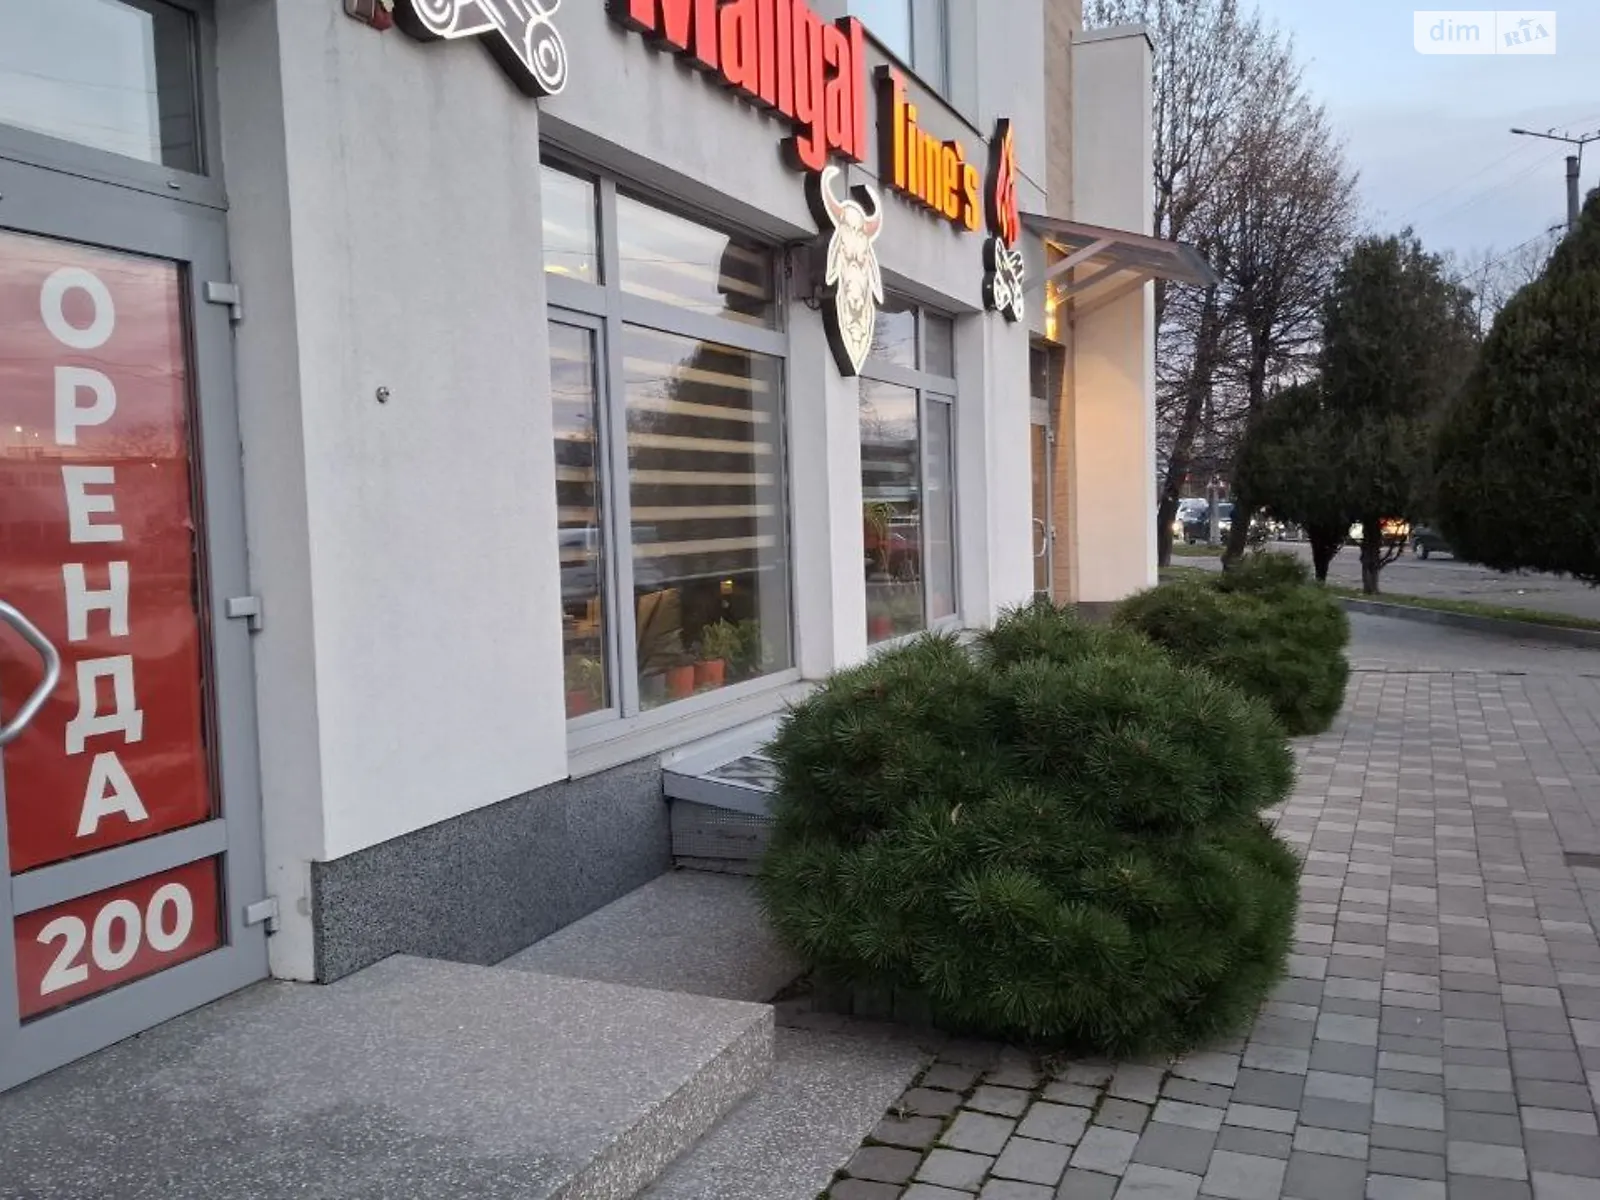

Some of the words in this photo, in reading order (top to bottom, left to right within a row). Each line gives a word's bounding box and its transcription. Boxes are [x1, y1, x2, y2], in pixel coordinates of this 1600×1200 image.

[629, 0, 868, 172] angal
[40, 267, 148, 837] ОРЕНДА
[36, 882, 193, 996] 200
